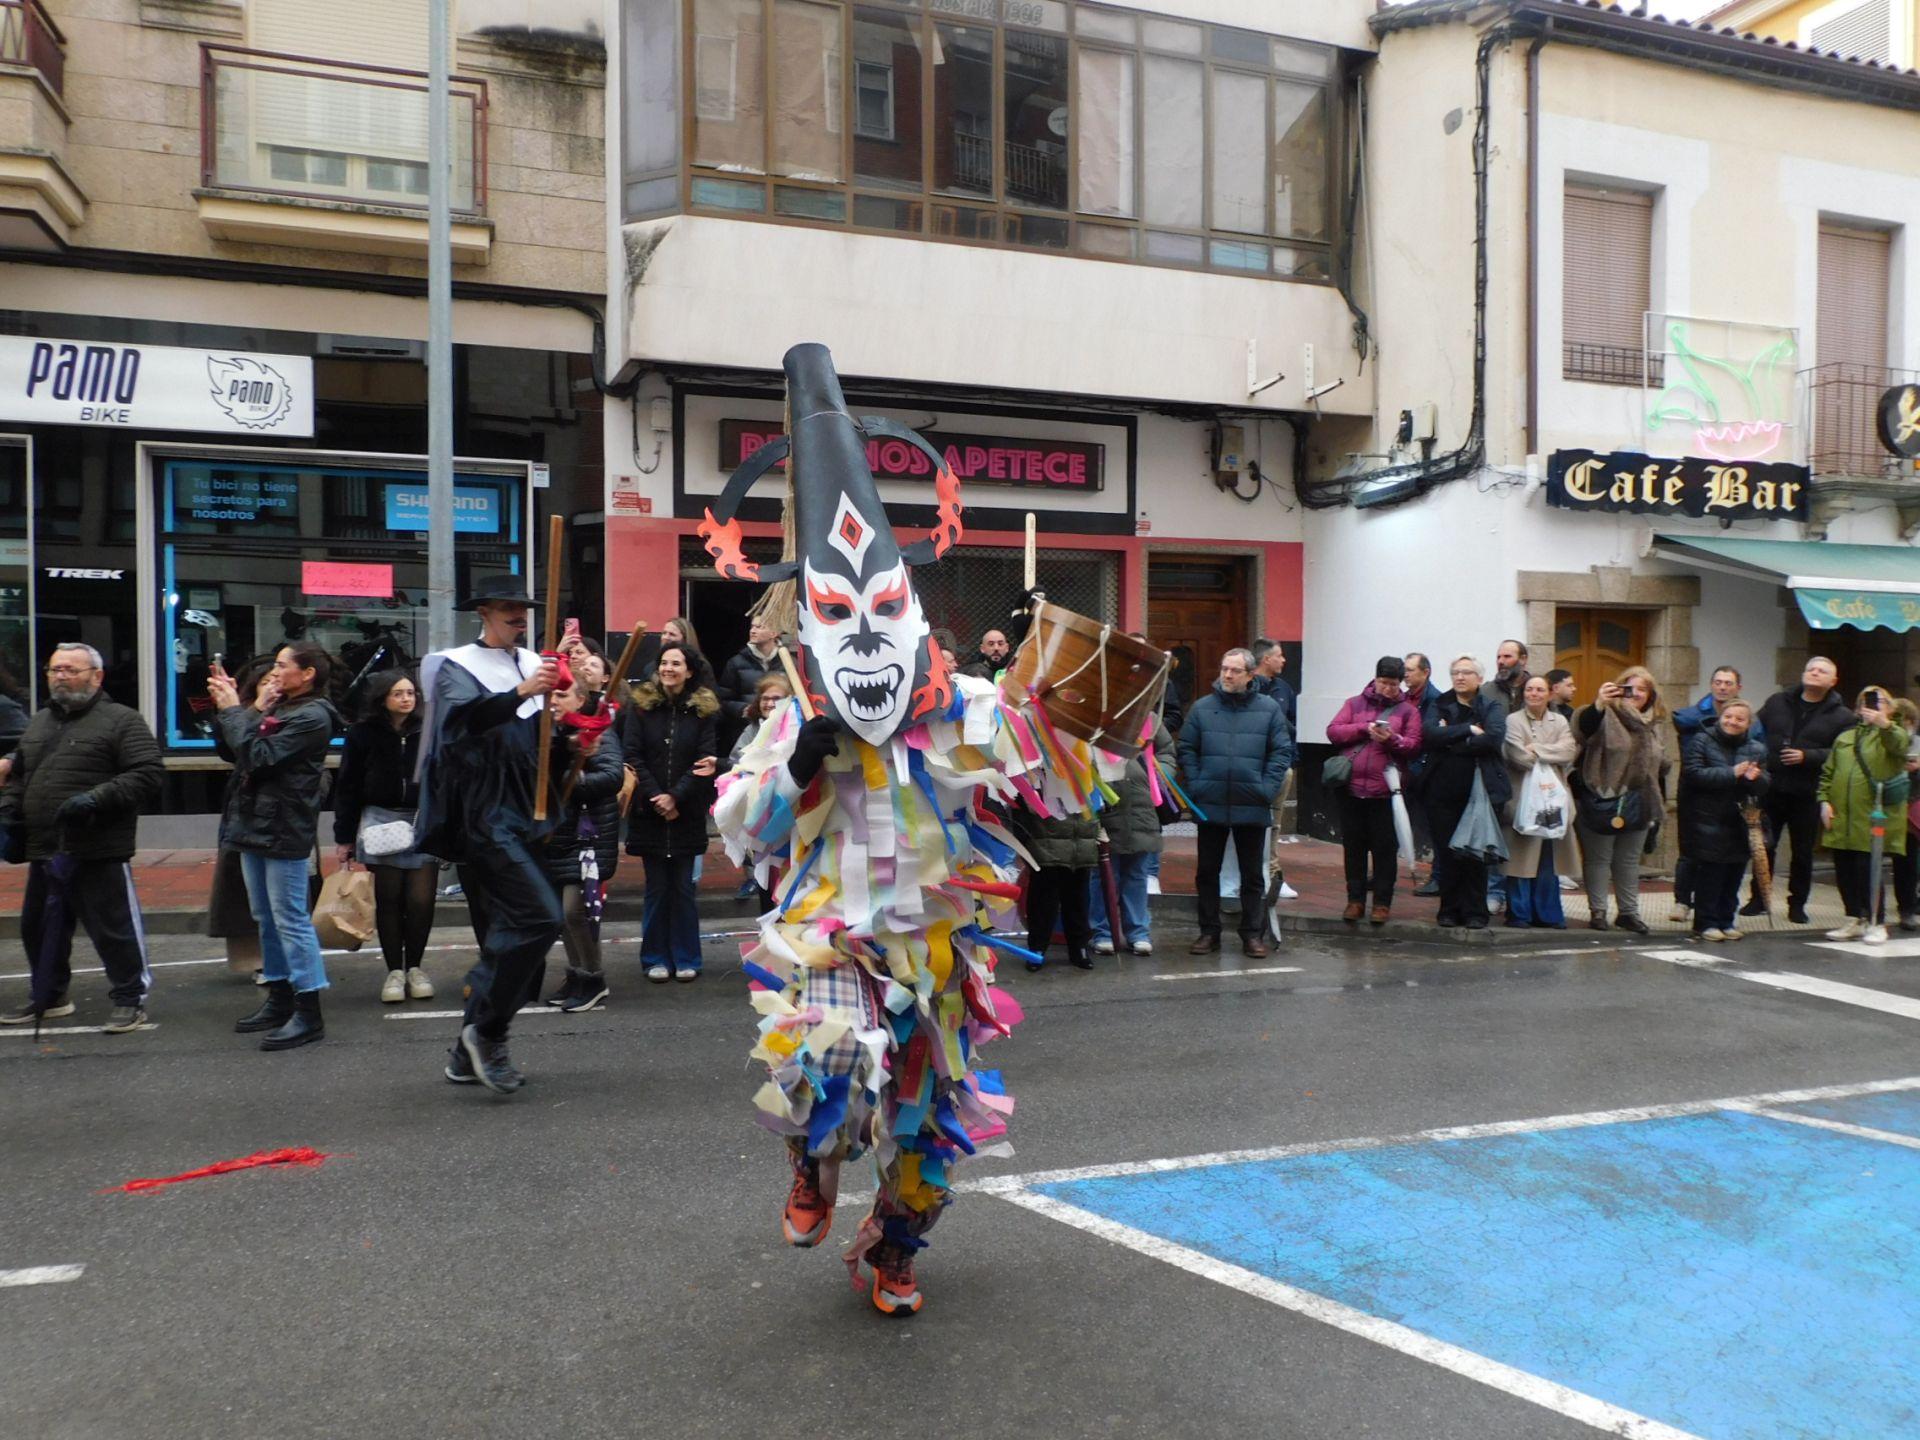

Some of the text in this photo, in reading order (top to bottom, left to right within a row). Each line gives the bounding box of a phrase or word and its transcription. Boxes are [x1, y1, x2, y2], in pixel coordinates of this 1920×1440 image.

[80, 407, 131, 423] BIKE
[943, 444, 1086, 483] APETECE
[193, 478, 297, 493] Tu bici no tiene
[1563, 459, 1802, 514] Café Bar
[192, 494, 288, 508] secretos para
[396, 493, 488, 510] SHIANO
[192, 509, 255, 520] nosotros
[44, 567, 125, 580] TREK
